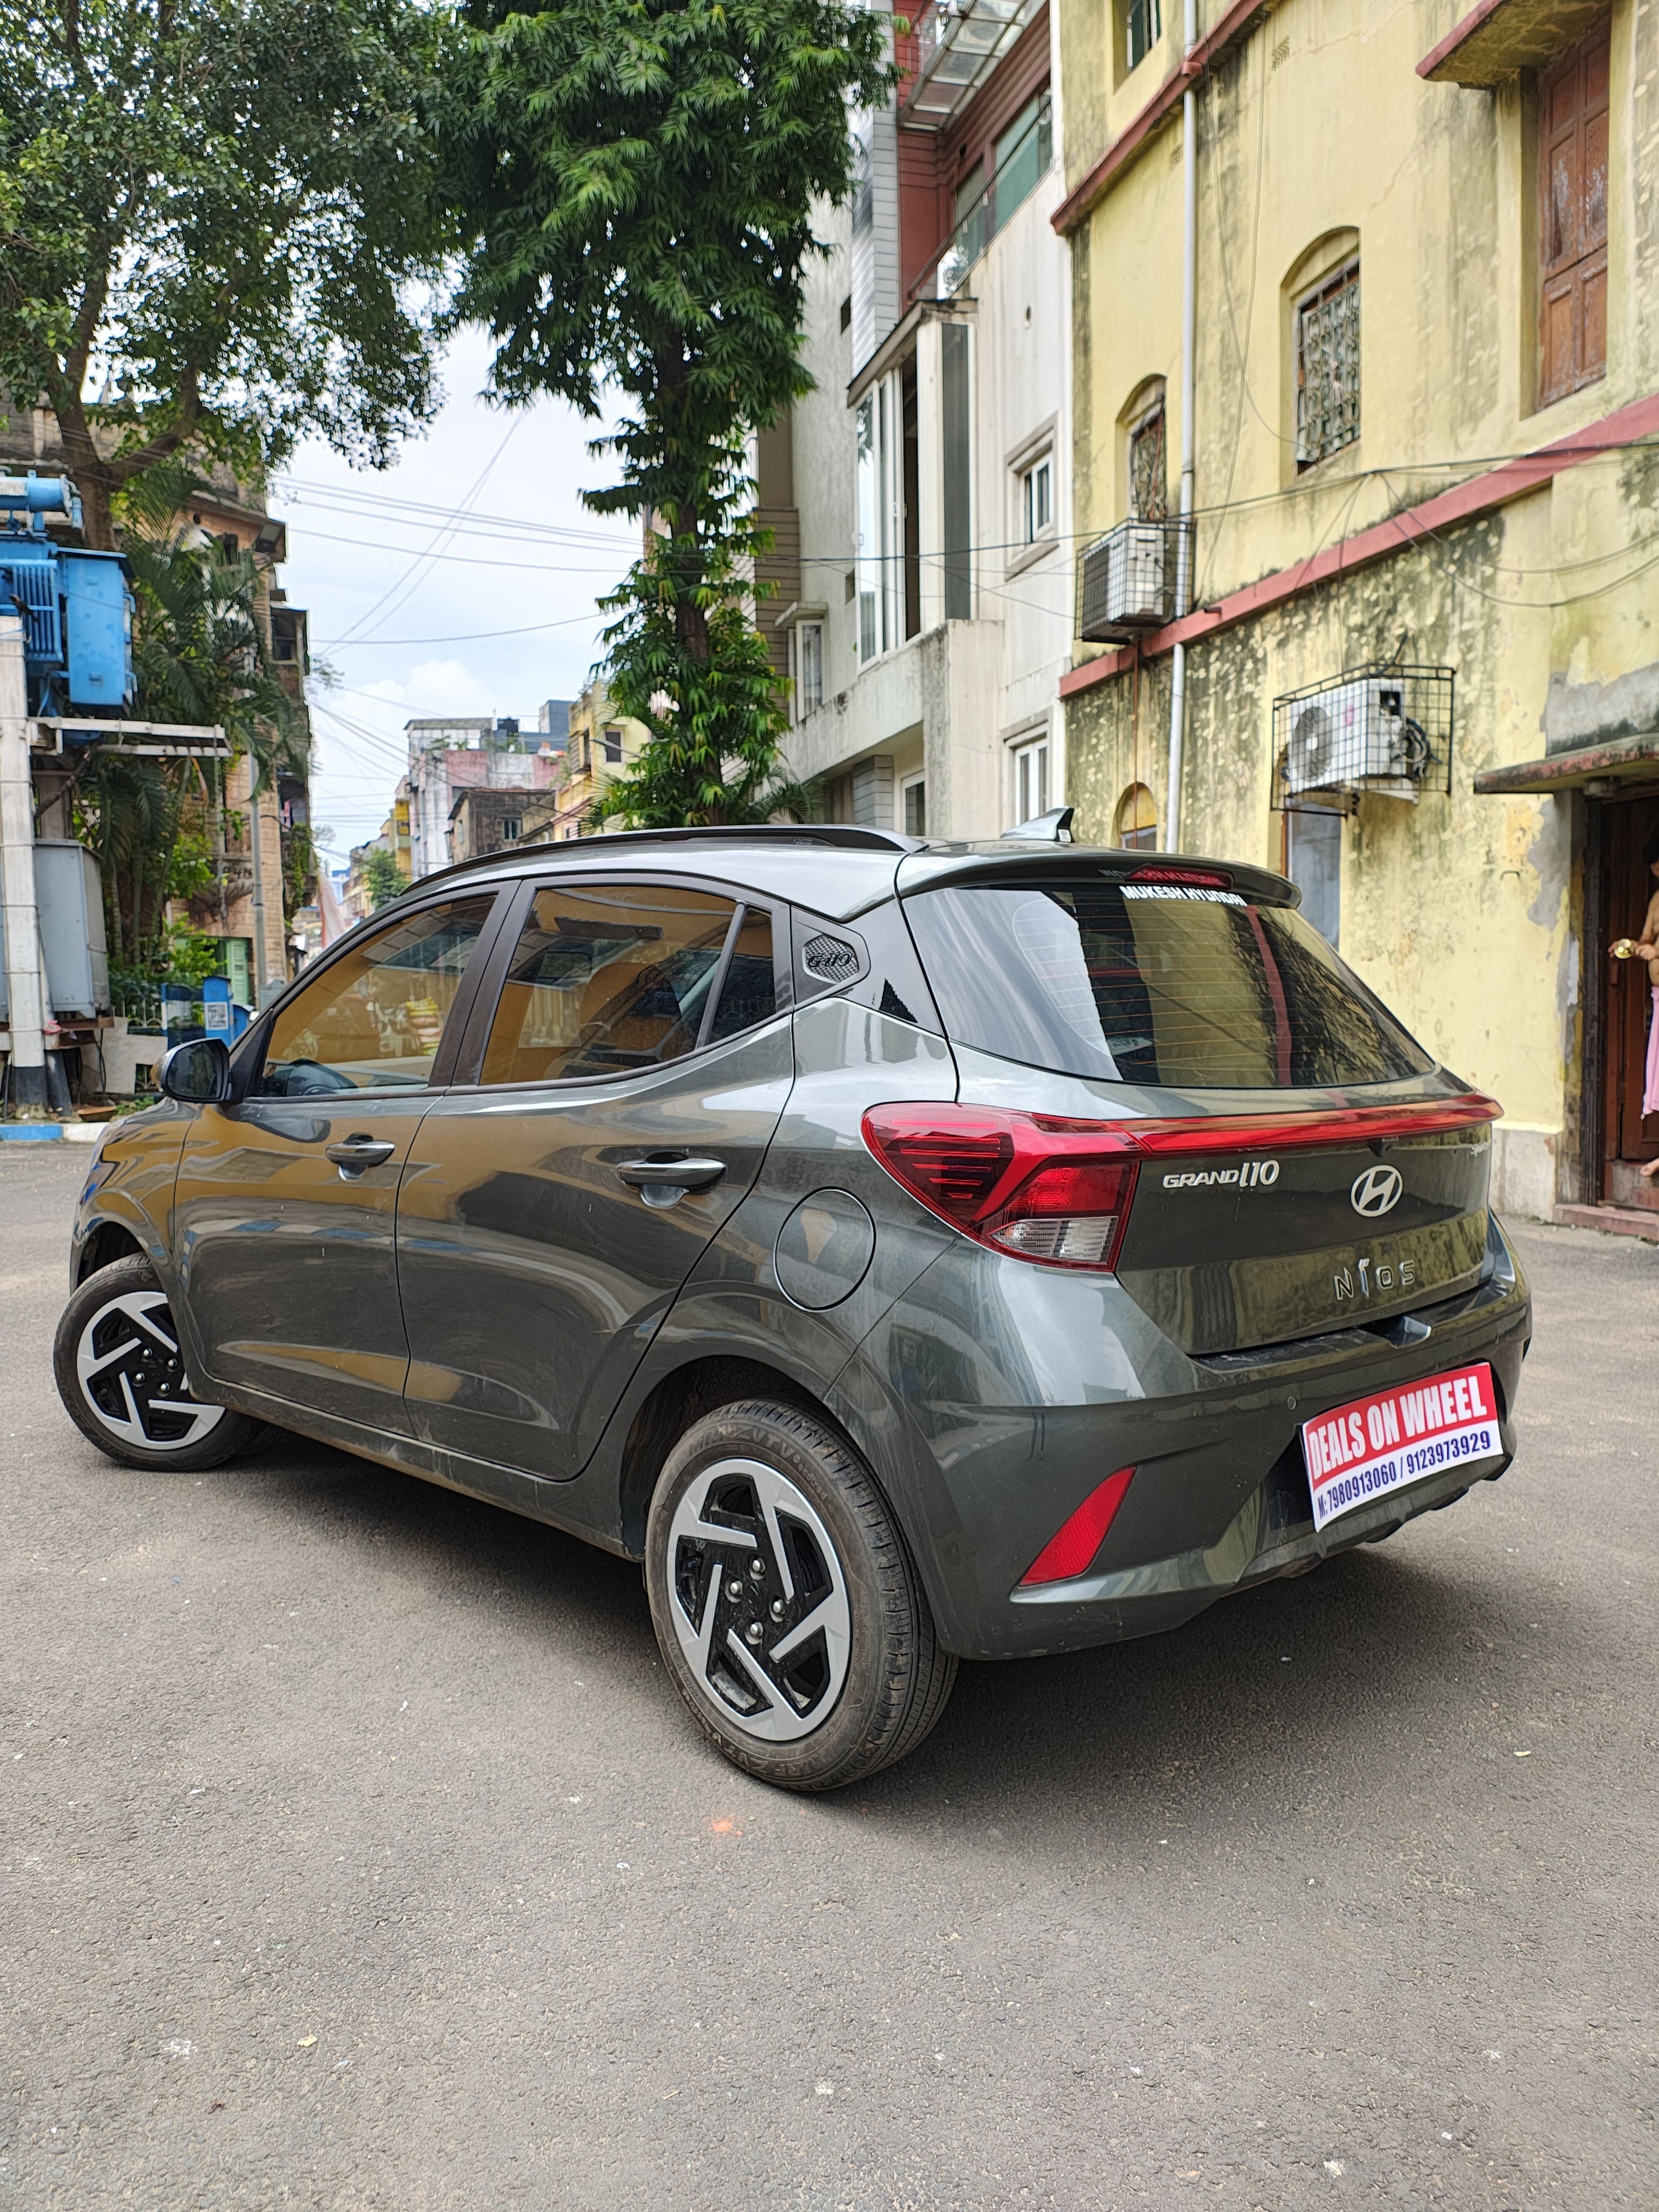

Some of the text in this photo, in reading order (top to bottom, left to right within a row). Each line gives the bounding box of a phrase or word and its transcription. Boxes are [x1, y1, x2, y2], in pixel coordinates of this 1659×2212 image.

[1119, 886, 1248, 906] MUKESH HYUNDAI
[1163, 1169, 1239, 1189] GRAND
[1309, 1375, 1487, 1480] DEALS ON WHEEL
[1327, 1461, 1397, 1512] 7980913060
[1406, 1431, 1491, 1474] 9123973929
